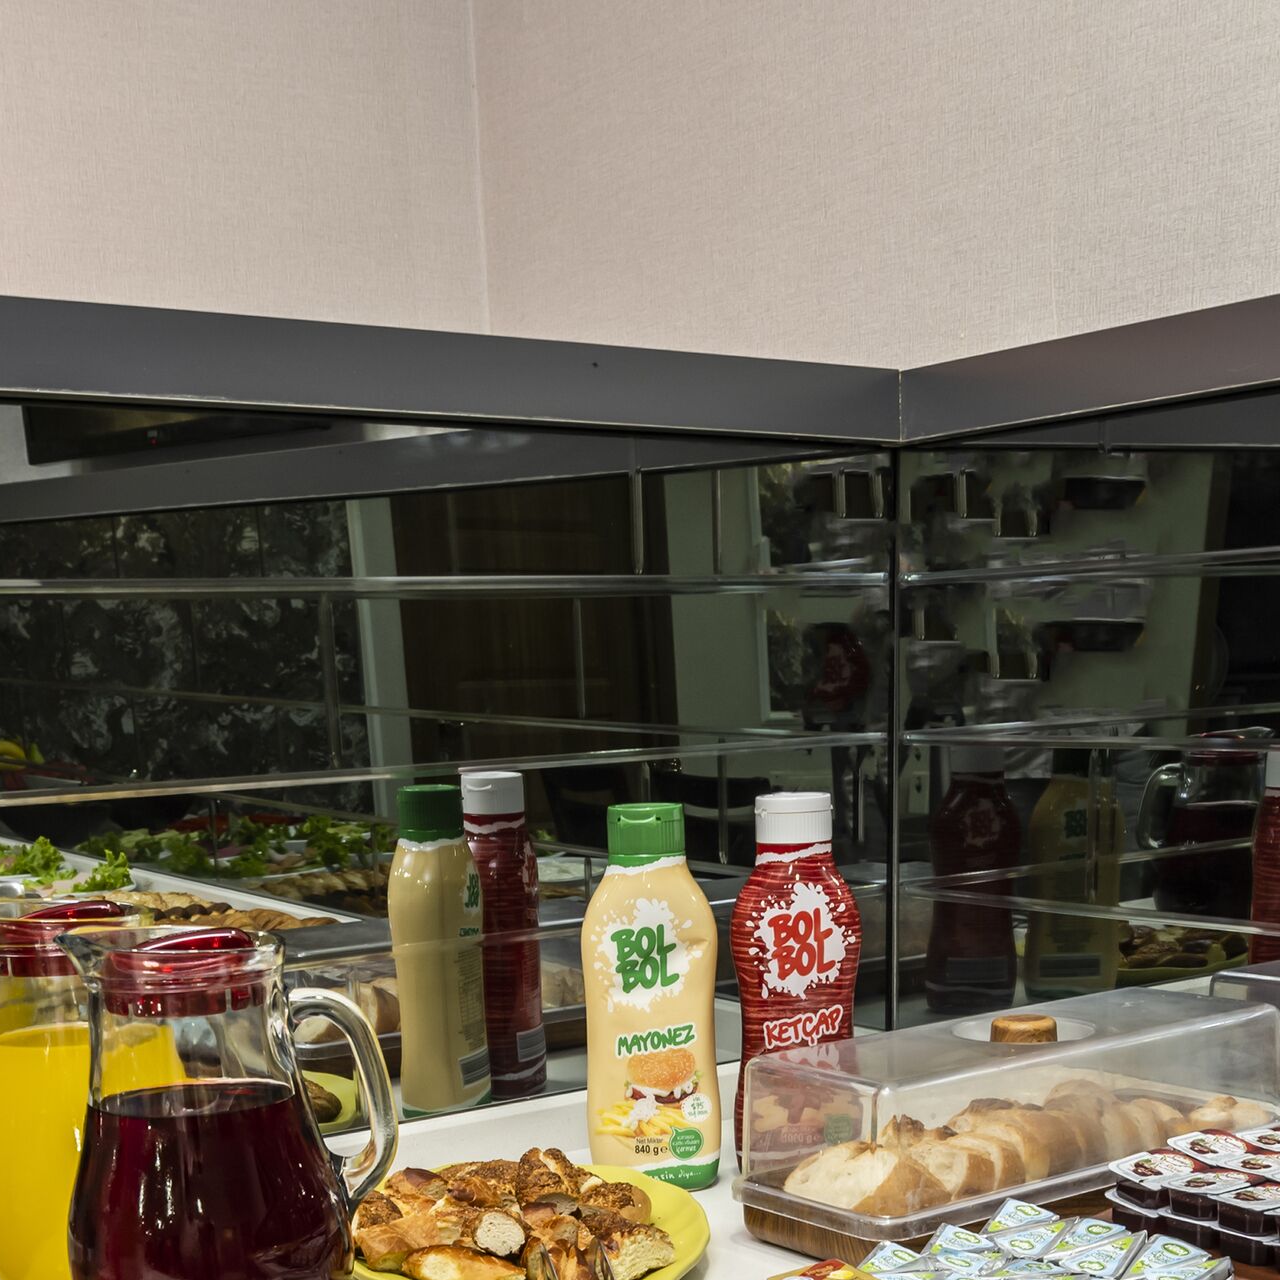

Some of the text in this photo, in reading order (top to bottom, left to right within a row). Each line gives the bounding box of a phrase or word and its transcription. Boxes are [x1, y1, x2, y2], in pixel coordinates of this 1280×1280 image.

[611, 924, 676, 961] BOL
[767, 907, 833, 947] BOL
[616, 956, 680, 993] BOL
[771, 941, 836, 980] BOL
[617, 1025, 695, 1056] MAYONEZ
[765, 1006, 841, 1047] KETÇAP
[635, 1145, 651, 1154] 840
[653, 1146, 659, 1155] g
